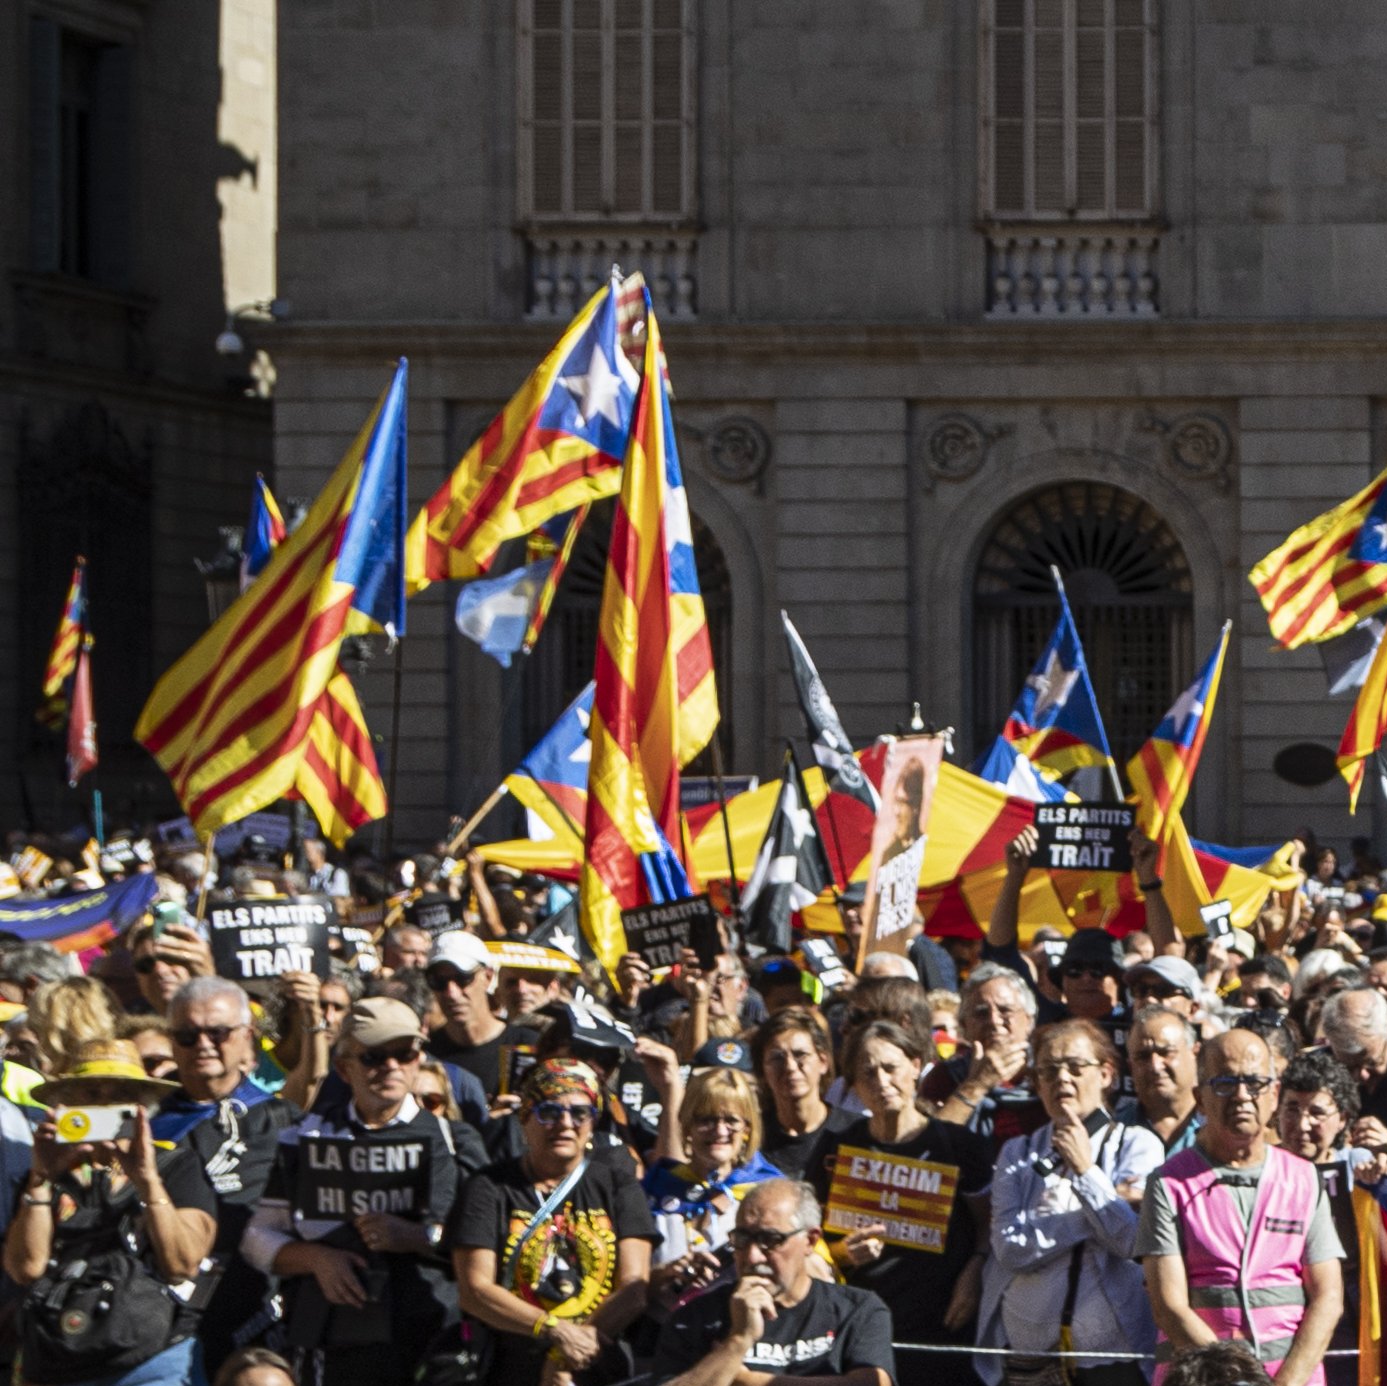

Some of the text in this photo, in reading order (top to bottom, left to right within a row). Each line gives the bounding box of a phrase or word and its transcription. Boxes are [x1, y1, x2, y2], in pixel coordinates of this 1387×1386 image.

[1038, 807, 1132, 827] ELS PARTITS
[1049, 841, 1115, 867] TRAÏT
[212, 907, 251, 930] ELS
[251, 903, 327, 926] PARTITS
[308, 1143, 424, 1173] LA GENT
[850, 1155, 943, 1195] EXIGIM
[317, 1187, 414, 1216] HI SOM
[880, 1189, 900, 1212] LA
